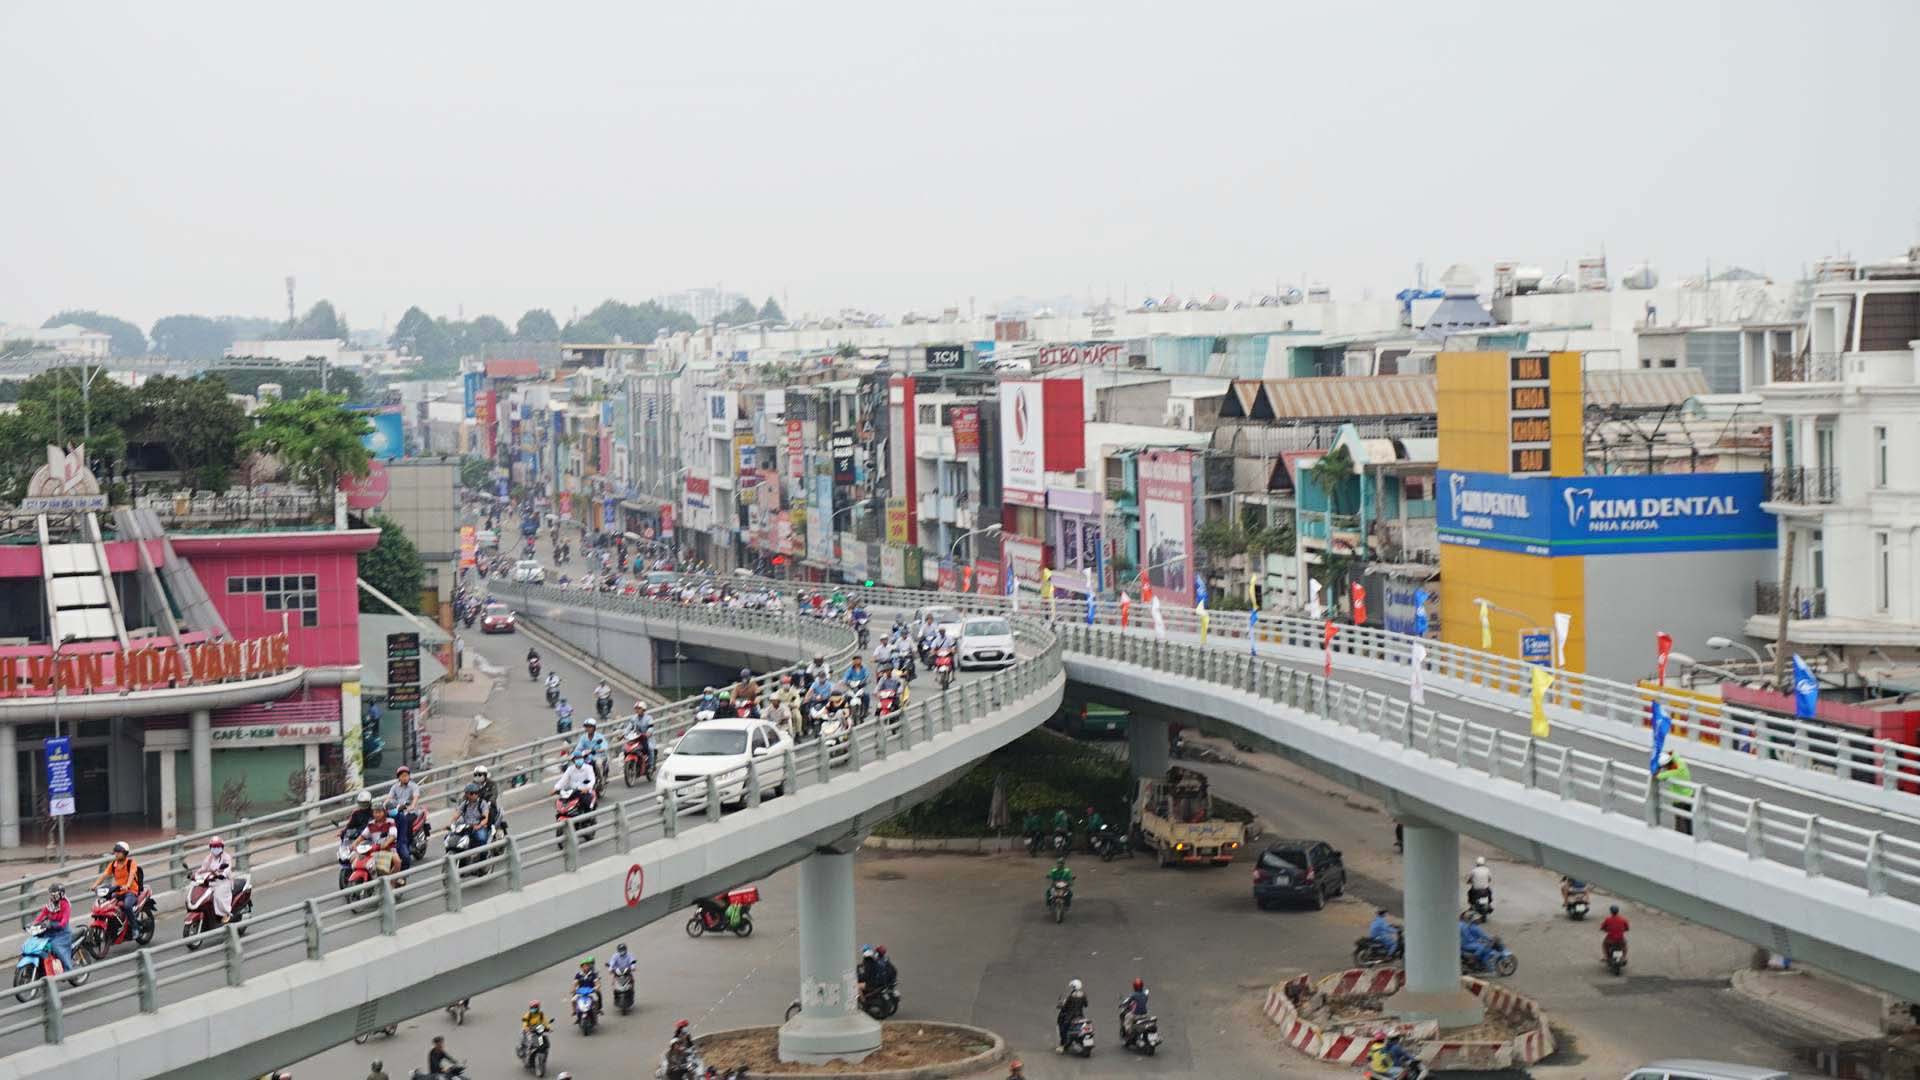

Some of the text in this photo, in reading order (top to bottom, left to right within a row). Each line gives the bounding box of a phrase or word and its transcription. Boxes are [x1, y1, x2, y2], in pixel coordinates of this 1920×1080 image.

[1039, 347, 1078, 365] BIBO
[1516, 388, 1545, 409] KHOA
[1589, 496, 1740, 519] KIM DENTAL
[1588, 519, 1658, 532] NHA KHOA
